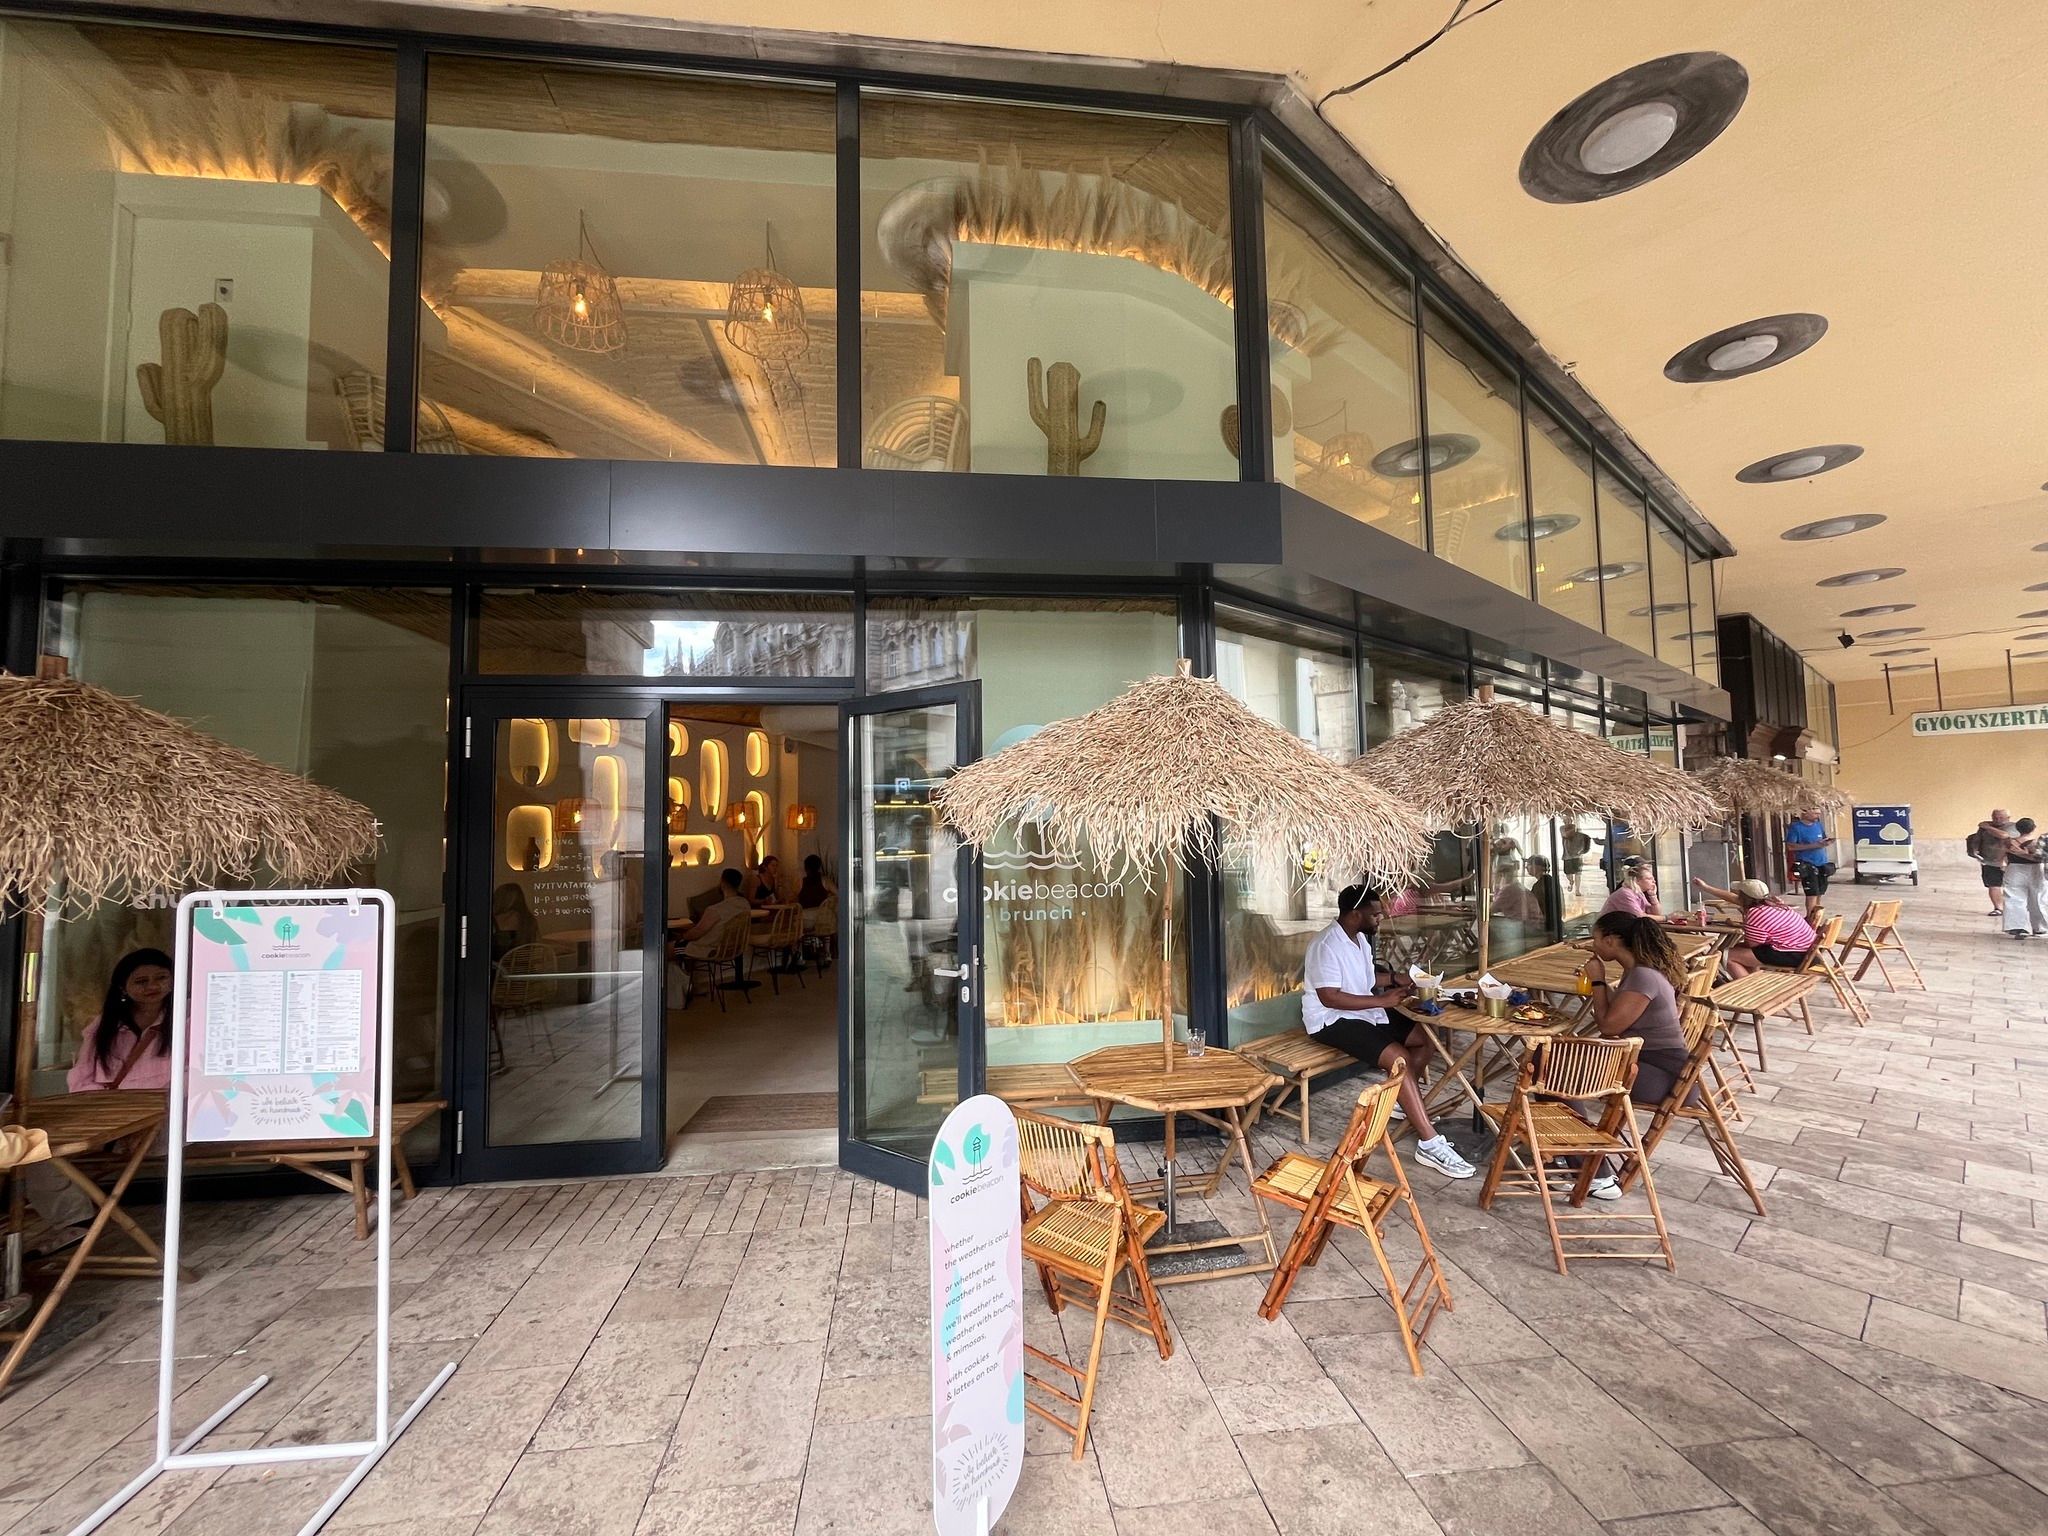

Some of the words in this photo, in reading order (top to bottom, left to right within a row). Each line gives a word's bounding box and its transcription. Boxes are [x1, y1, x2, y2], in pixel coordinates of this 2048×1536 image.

[942, 879, 1124, 902] cokiebeacon
[1000, 906, 1073, 922] brunch
[950, 1175, 1004, 1204] cookiebeacon
[944, 1234, 974, 1254] whether
[944, 1258, 957, 1271] the
[958, 1242, 987, 1262] weather
[988, 1239, 994, 1248] is
[945, 1284, 953, 1293] or
[954, 1266, 983, 1288] whether
[984, 1260, 996, 1271] the
[945, 1287, 975, 1308] weather
[976, 1282, 982, 1291] is
[963, 1299, 992, 1321] weather
[993, 1292, 1004, 1303] the
[945, 1324, 976, 1347] weather
[977, 1313, 992, 1328] with
[993, 1299, 1015, 1318] brunch
[946, 1352, 952, 1362] &
[946, 1370, 963, 1385] with
[964, 1352, 990, 1374] cookies
[946, 1391, 953, 1401] &
[953, 1378, 975, 1397] lattes
[976, 1371, 985, 1381] on
